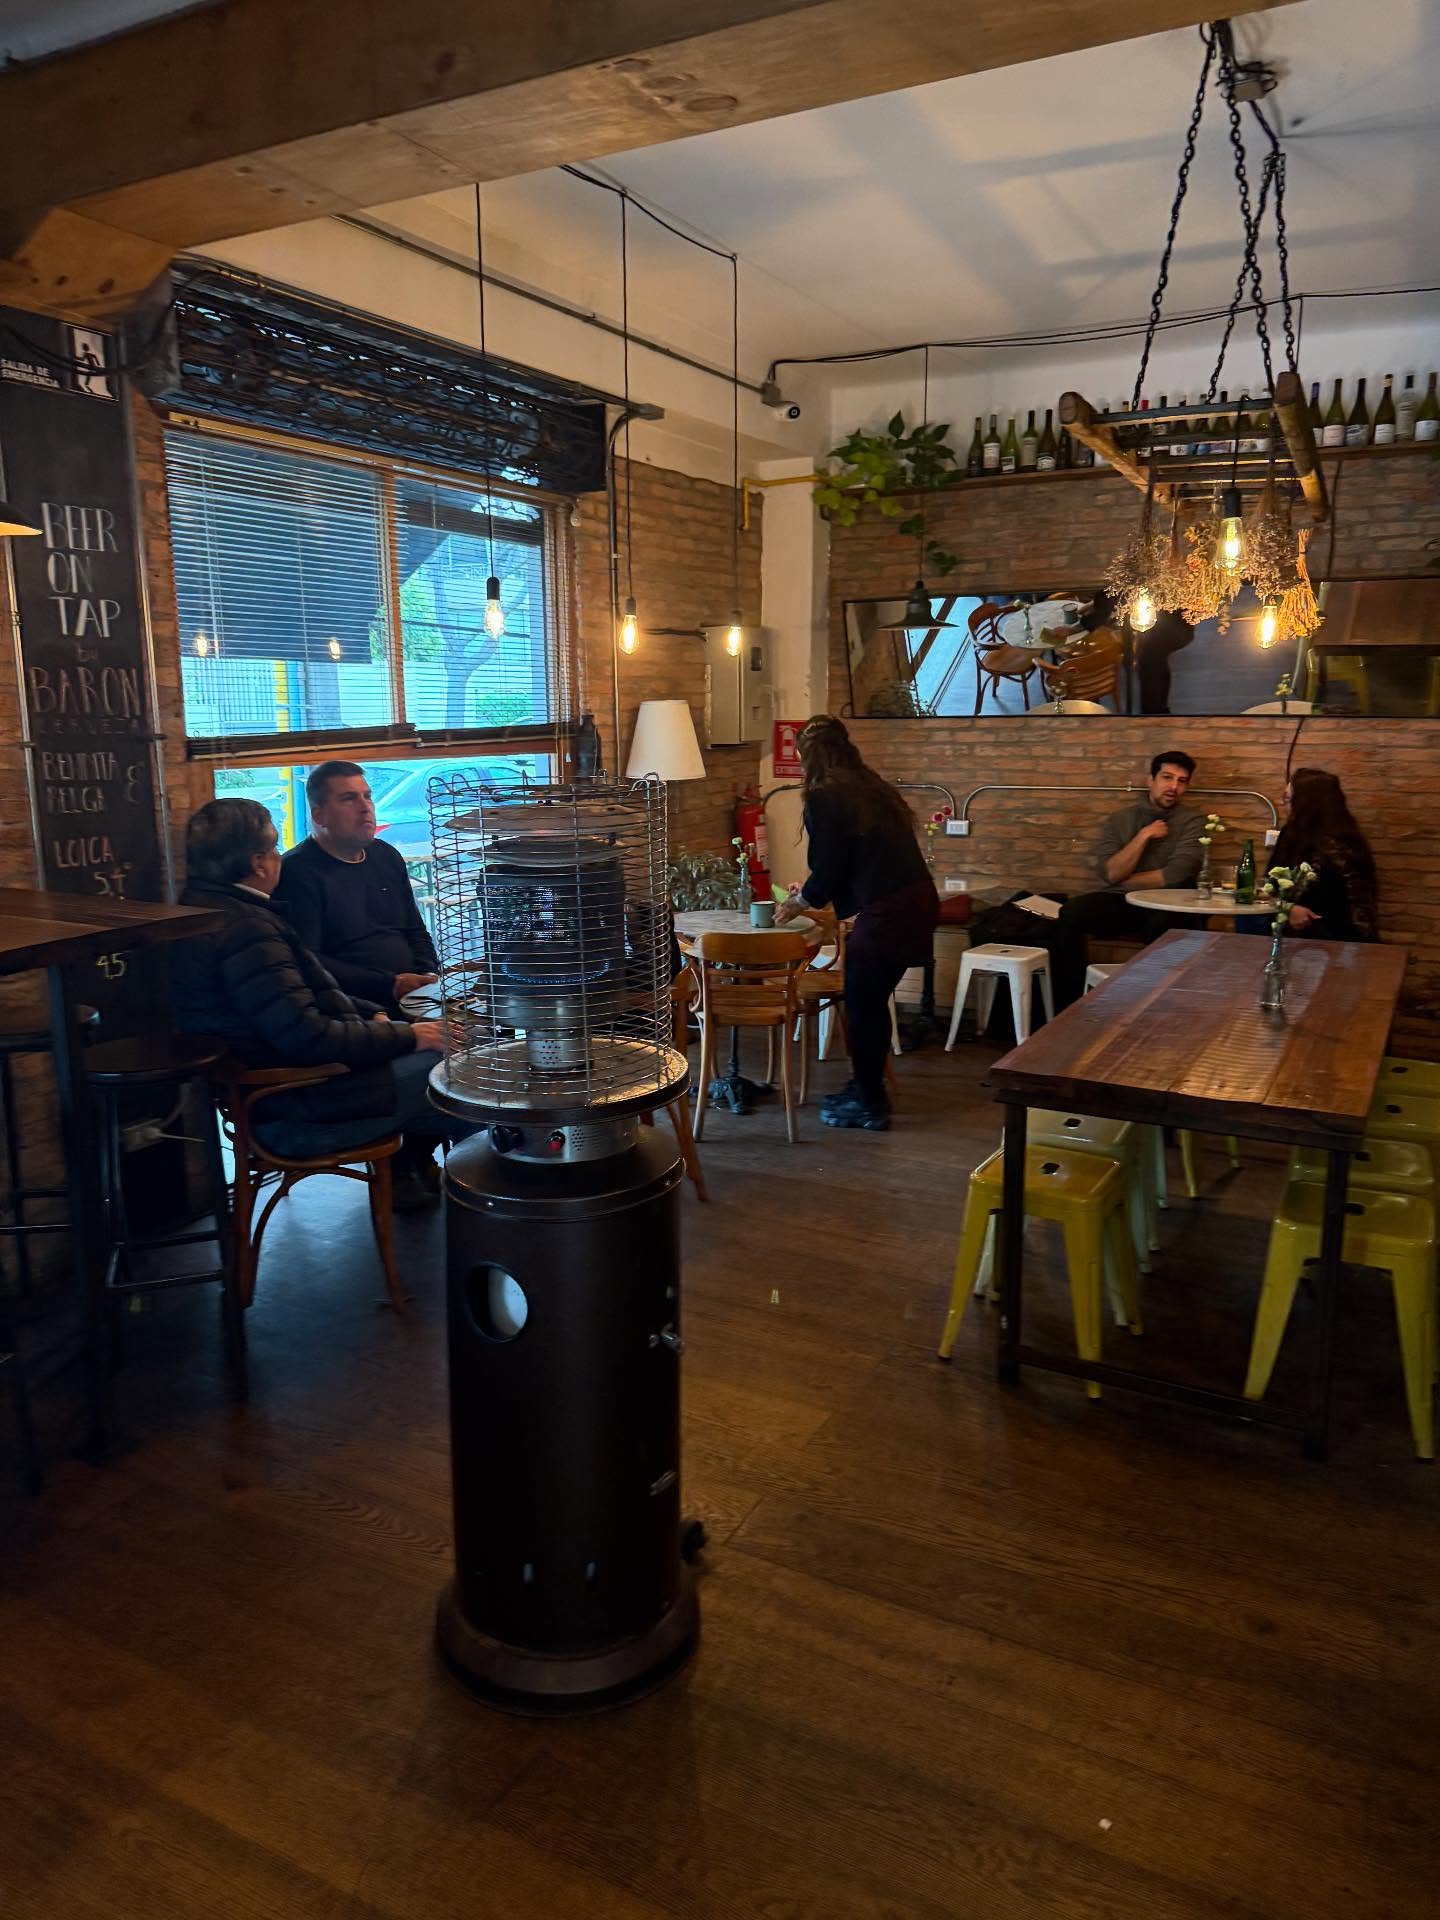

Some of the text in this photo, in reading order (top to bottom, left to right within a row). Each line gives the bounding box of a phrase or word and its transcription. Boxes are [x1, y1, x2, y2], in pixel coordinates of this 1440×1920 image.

[42, 502, 119, 552] BEER
[47, 551, 94, 594] ON
[48, 595, 120, 638] TAP
